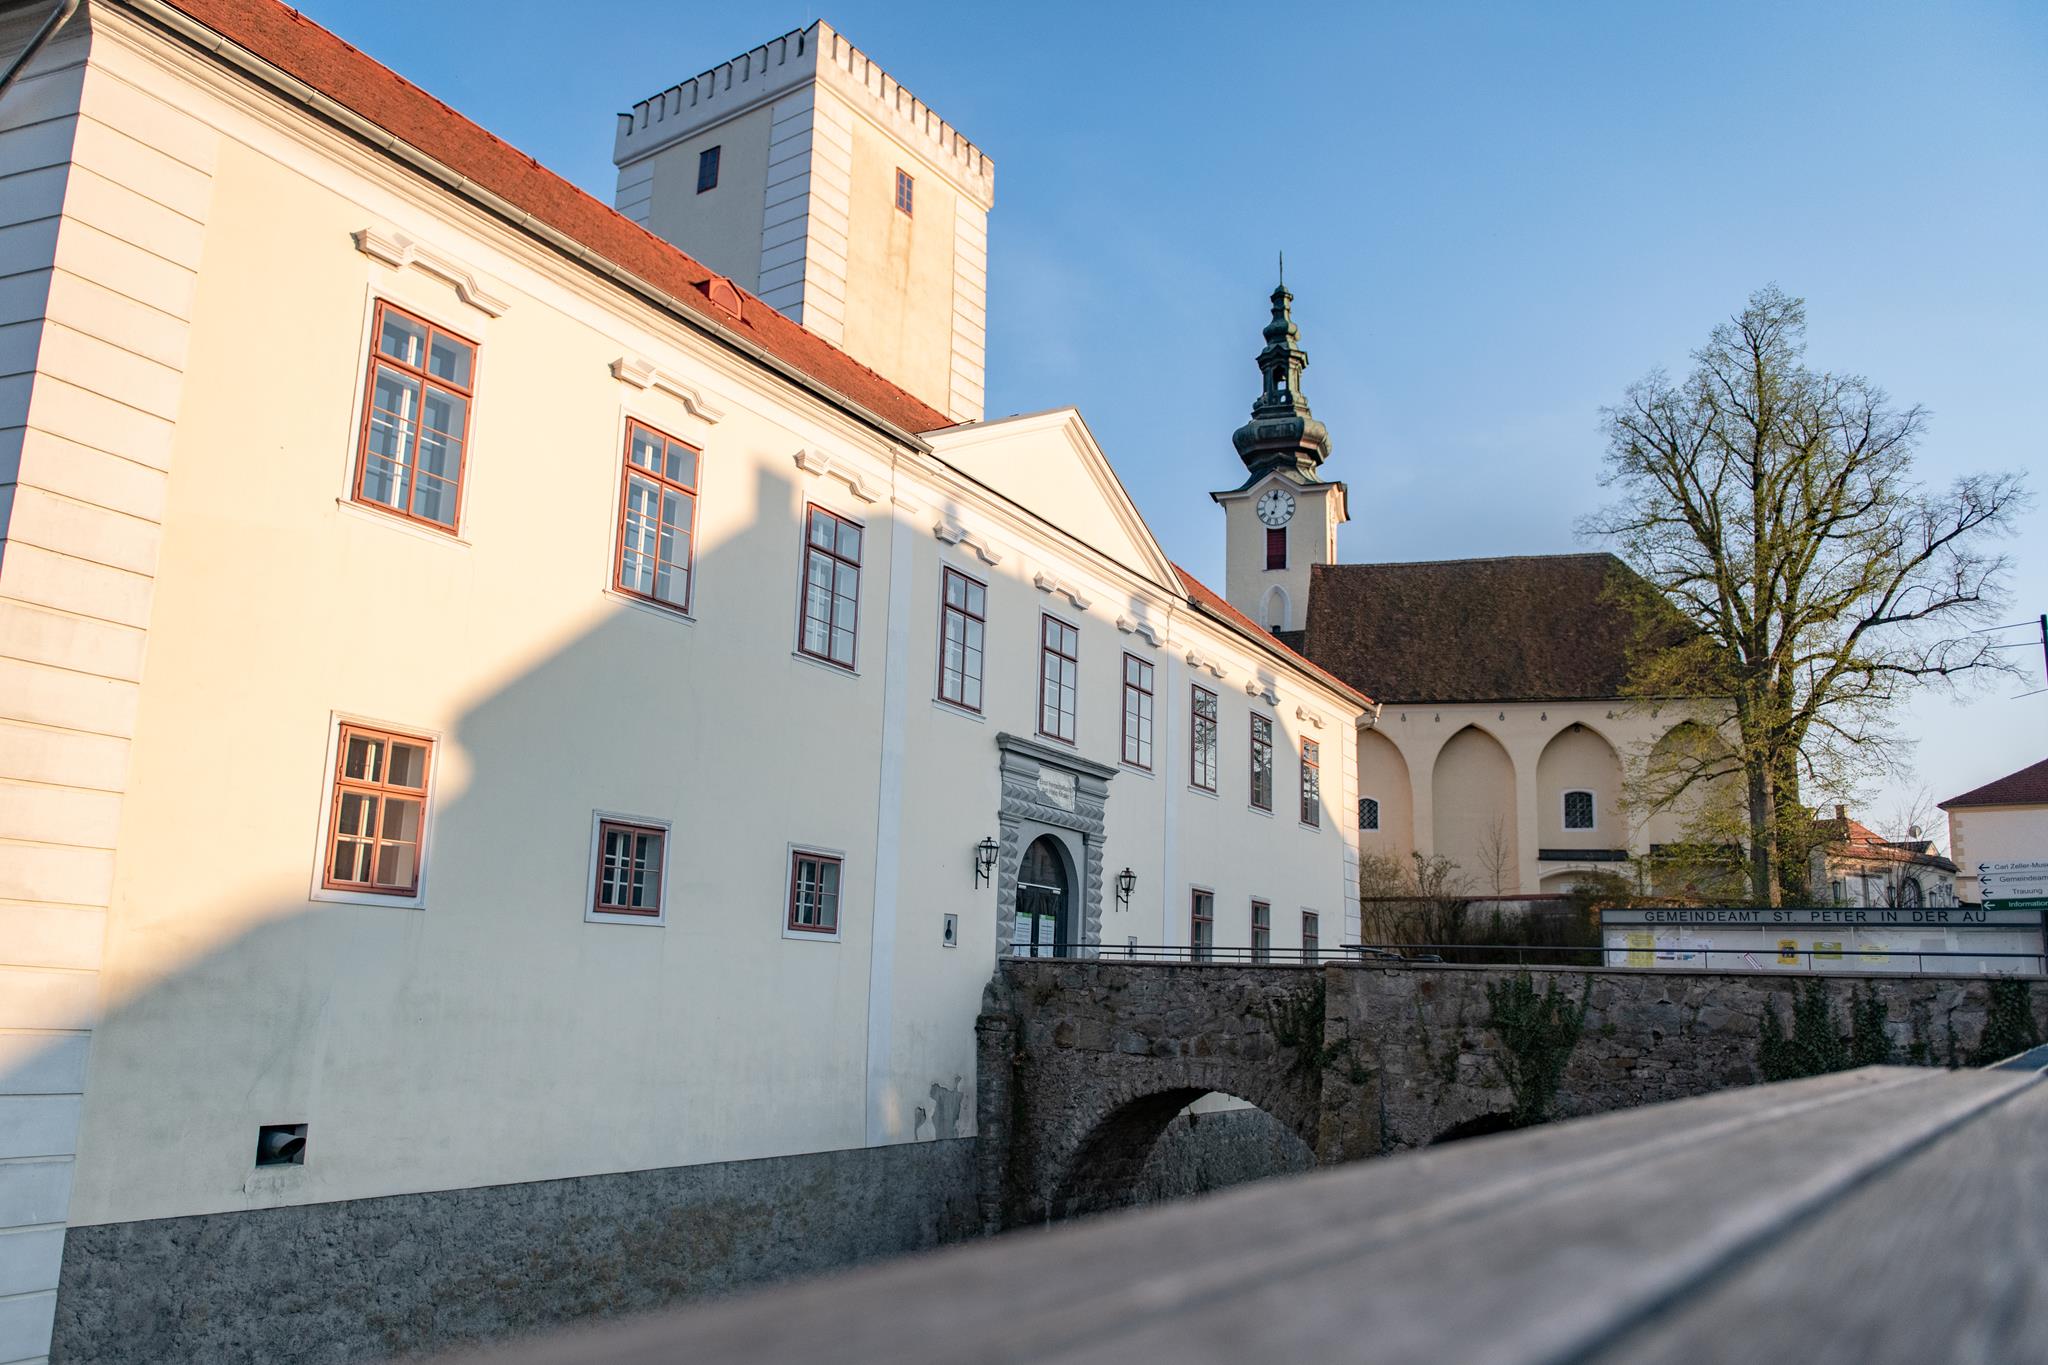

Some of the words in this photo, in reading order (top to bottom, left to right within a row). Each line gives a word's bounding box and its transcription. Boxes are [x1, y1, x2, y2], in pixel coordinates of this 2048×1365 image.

[1644, 911, 1761, 922] GEMEINDEAMT
[1773, 911, 1797, 922] ST.
[1811, 911, 1867, 922] PETER
[1881, 911, 1898, 922] IN
[1912, 911, 1949, 922] DER
[1962, 911, 1987, 923] AU
